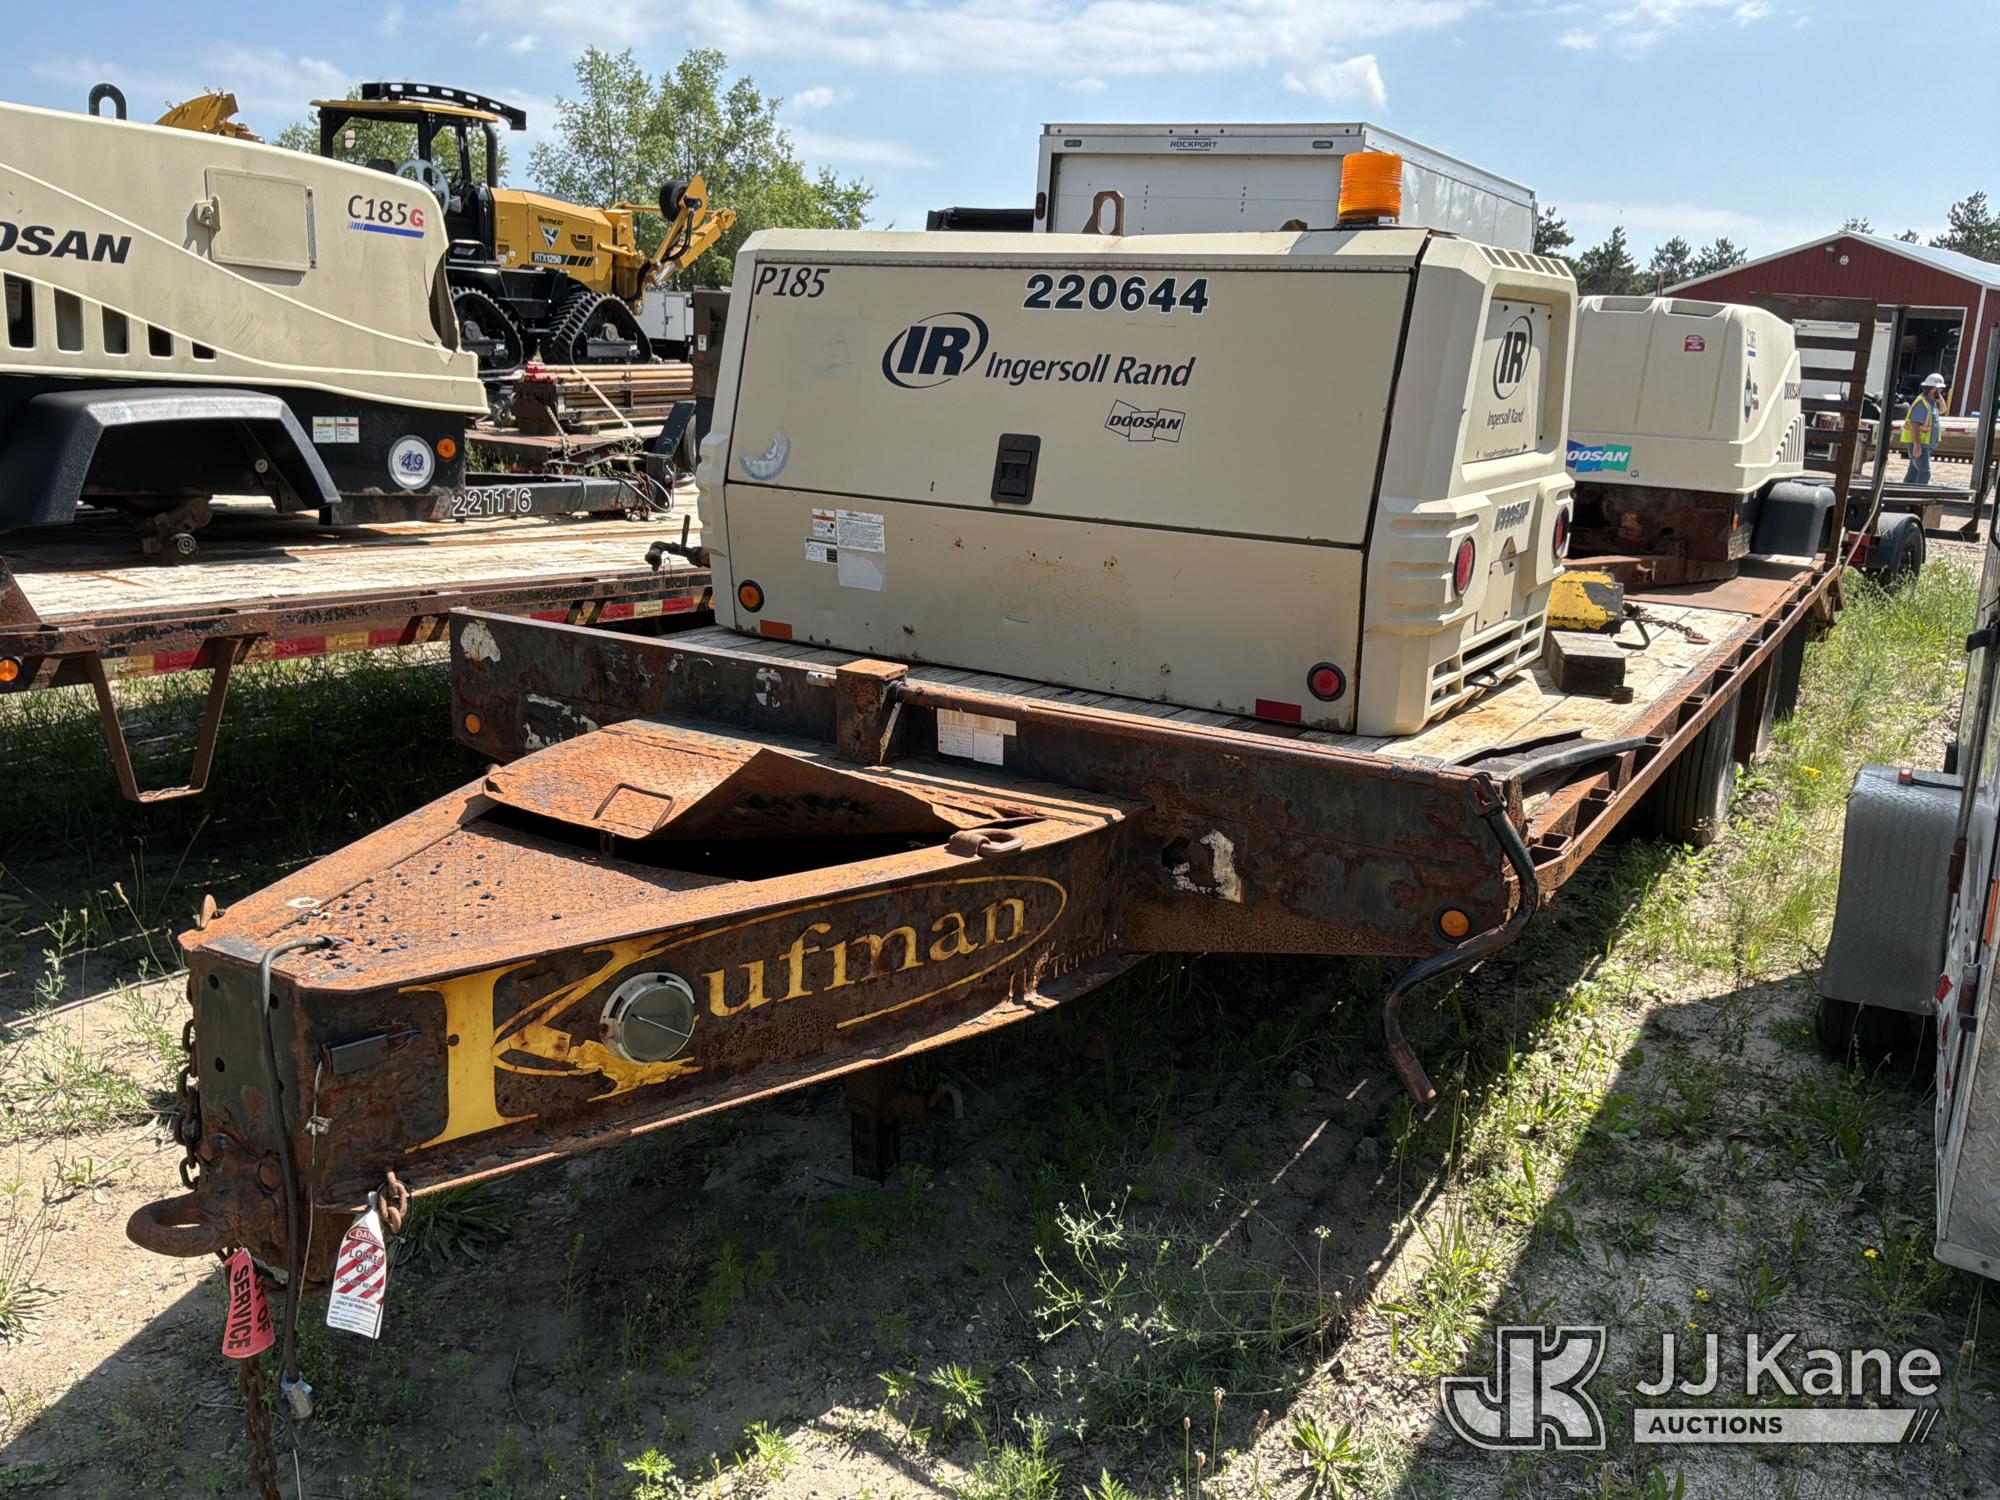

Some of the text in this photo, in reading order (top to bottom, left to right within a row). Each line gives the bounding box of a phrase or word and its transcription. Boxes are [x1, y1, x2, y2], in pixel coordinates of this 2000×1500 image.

[1170, 140, 1218, 148] ROCKPORT
[347, 194, 425, 228] C185G
[537, 215, 563, 225] Vermeer
[755, 266, 831, 298] P185
[1022, 273, 1210, 315] 220644
[896, 325, 971, 376] IR
[1498, 331, 1527, 384] IR
[984, 351, 1196, 387] Ingersoll Rand
[1108, 415, 1181, 431] DOOSAN
[1486, 407, 1524, 430] Ingersoll Rand
[1566, 450, 1629, 463] OOSAN
[452, 487, 532, 517] 221116
[398, 895, 1028, 1154] Kufman
[227, 1264, 252, 1350] SERVICE
